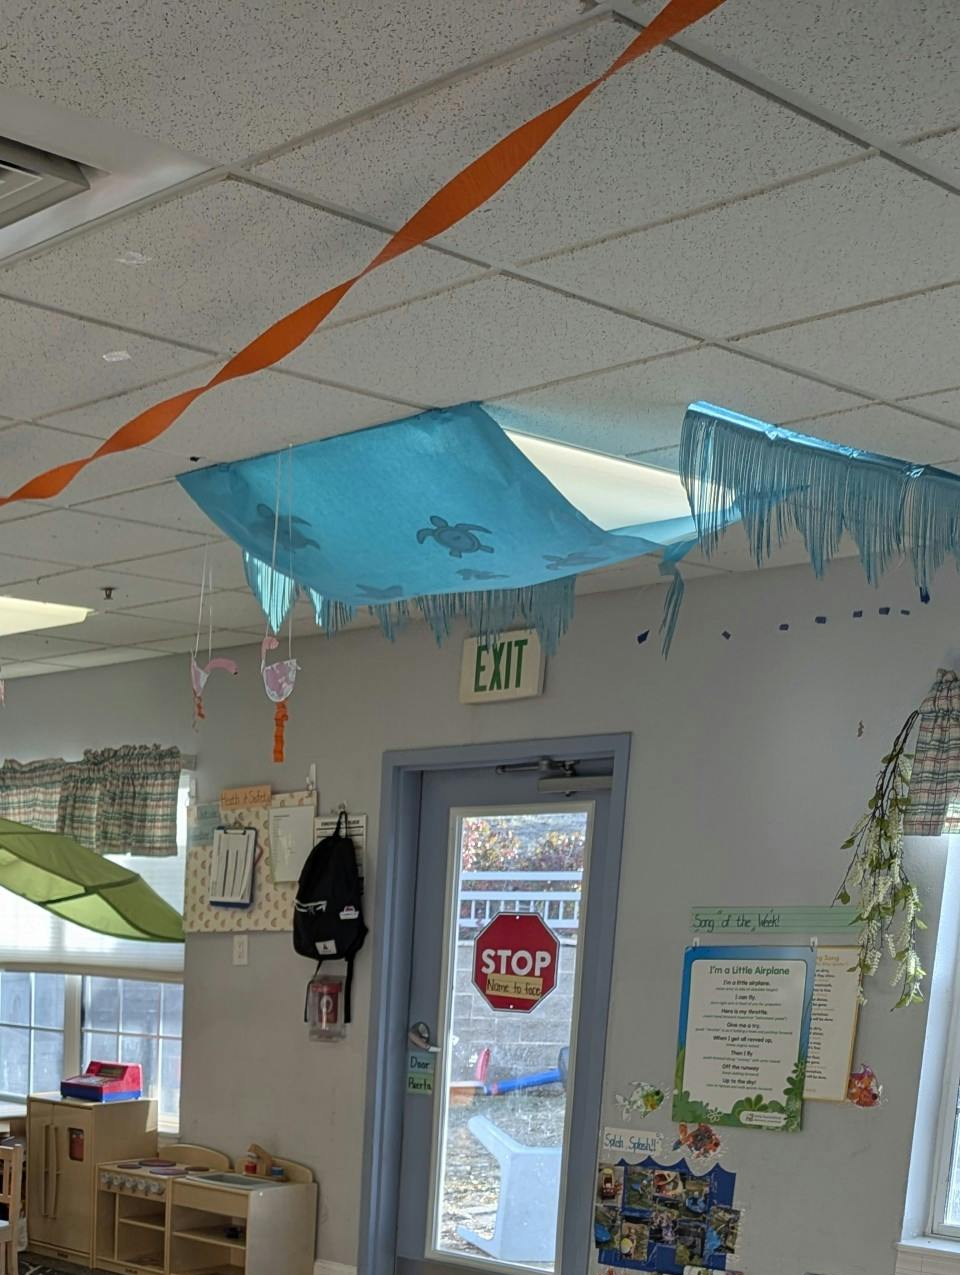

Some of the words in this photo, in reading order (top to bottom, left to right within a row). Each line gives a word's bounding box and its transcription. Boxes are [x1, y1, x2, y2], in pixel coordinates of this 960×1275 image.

[473, 638, 529, 693] EXIT
[692, 913, 715, 934] Song
[721, 913, 732, 929] of
[736, 912, 752, 928] the
[481, 948, 552, 977] STOP
[709, 965, 723, 975] I'm
[724, 967, 730, 975] a
[732, 965, 753, 975] Little
[754, 966, 790, 977] Airplane
[487, 978, 509, 993] Name
[513, 980, 522, 995] to
[525, 982, 541, 997] face
[410, 1055, 431, 1069] Door
